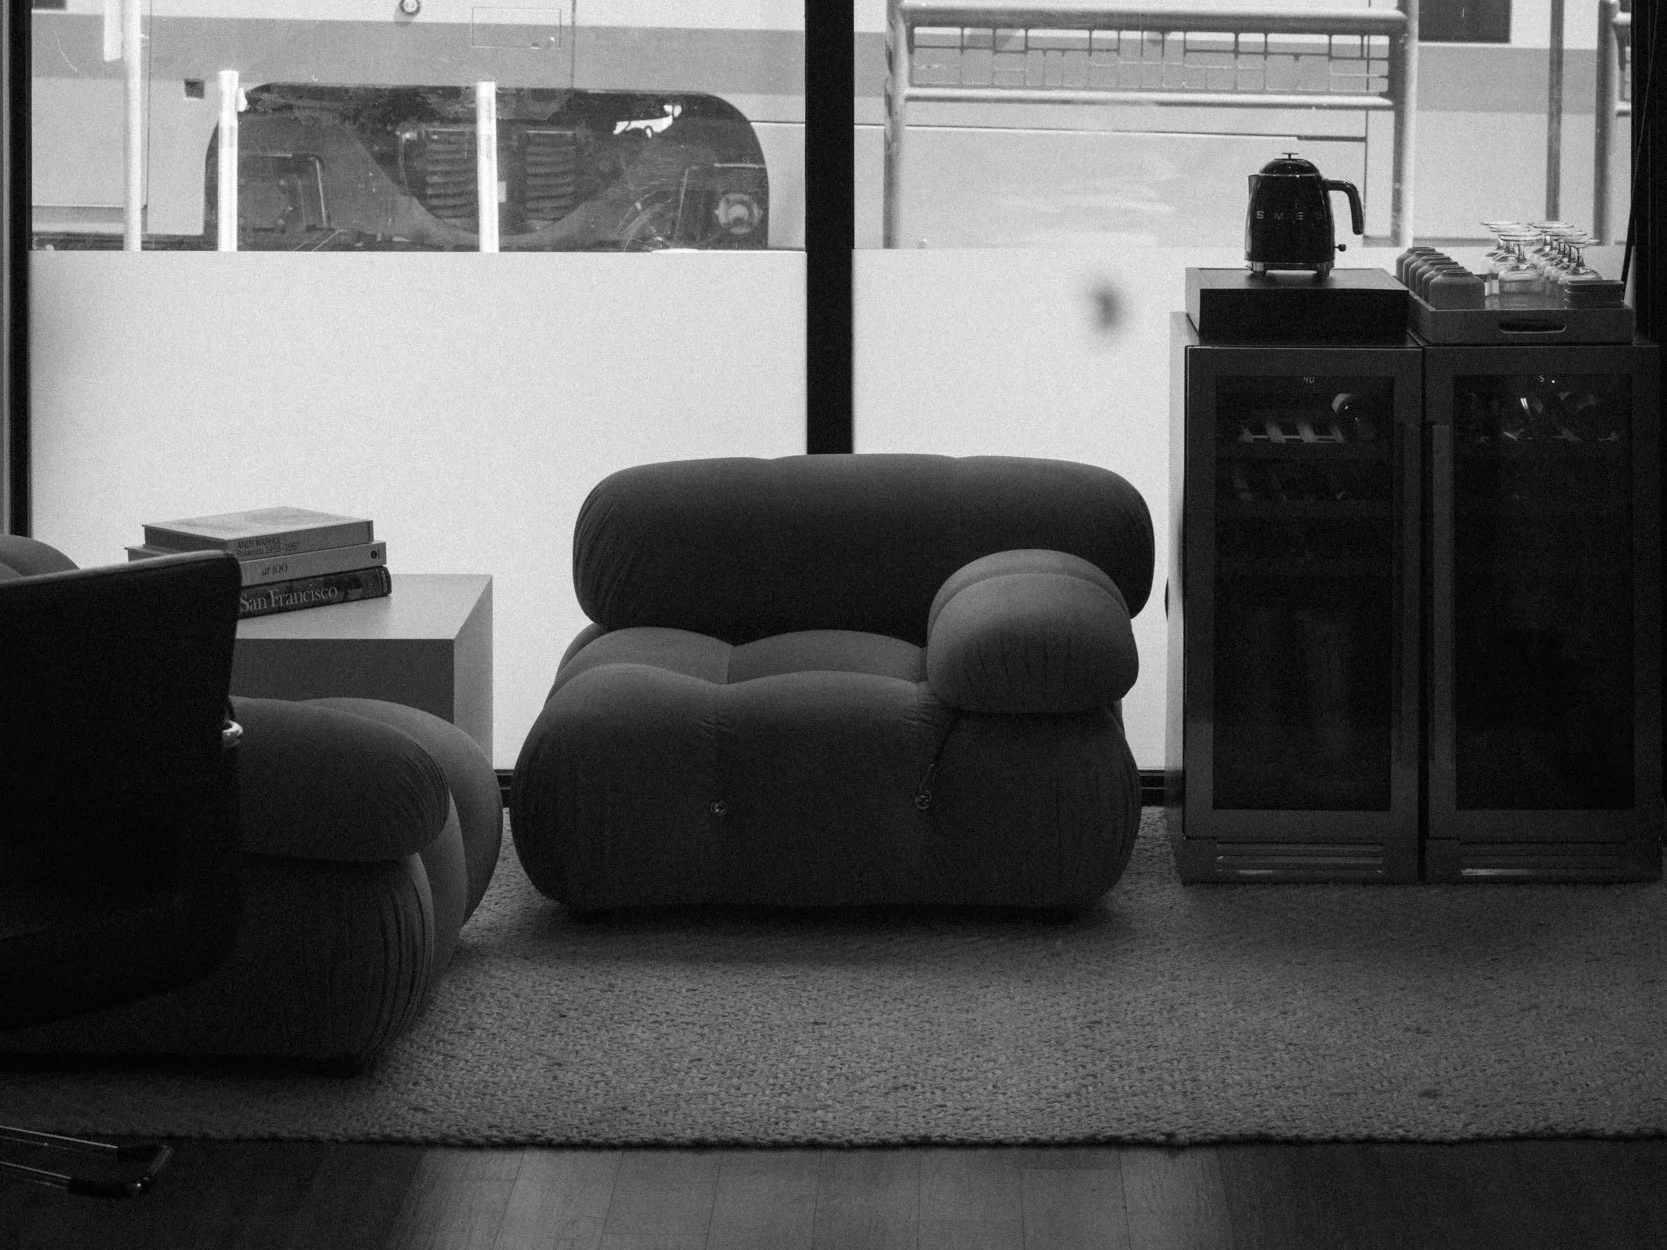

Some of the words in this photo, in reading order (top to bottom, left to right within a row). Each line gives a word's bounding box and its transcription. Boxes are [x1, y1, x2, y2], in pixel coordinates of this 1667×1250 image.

[1256, 210, 1323, 221] SMEG
[237, 540, 255, 549] ANDY
[256, 537, 281, 547] WARHOL
[261, 566, 270, 576] at
[240, 593, 267, 612] San
[268, 586, 338, 609] Francisco
